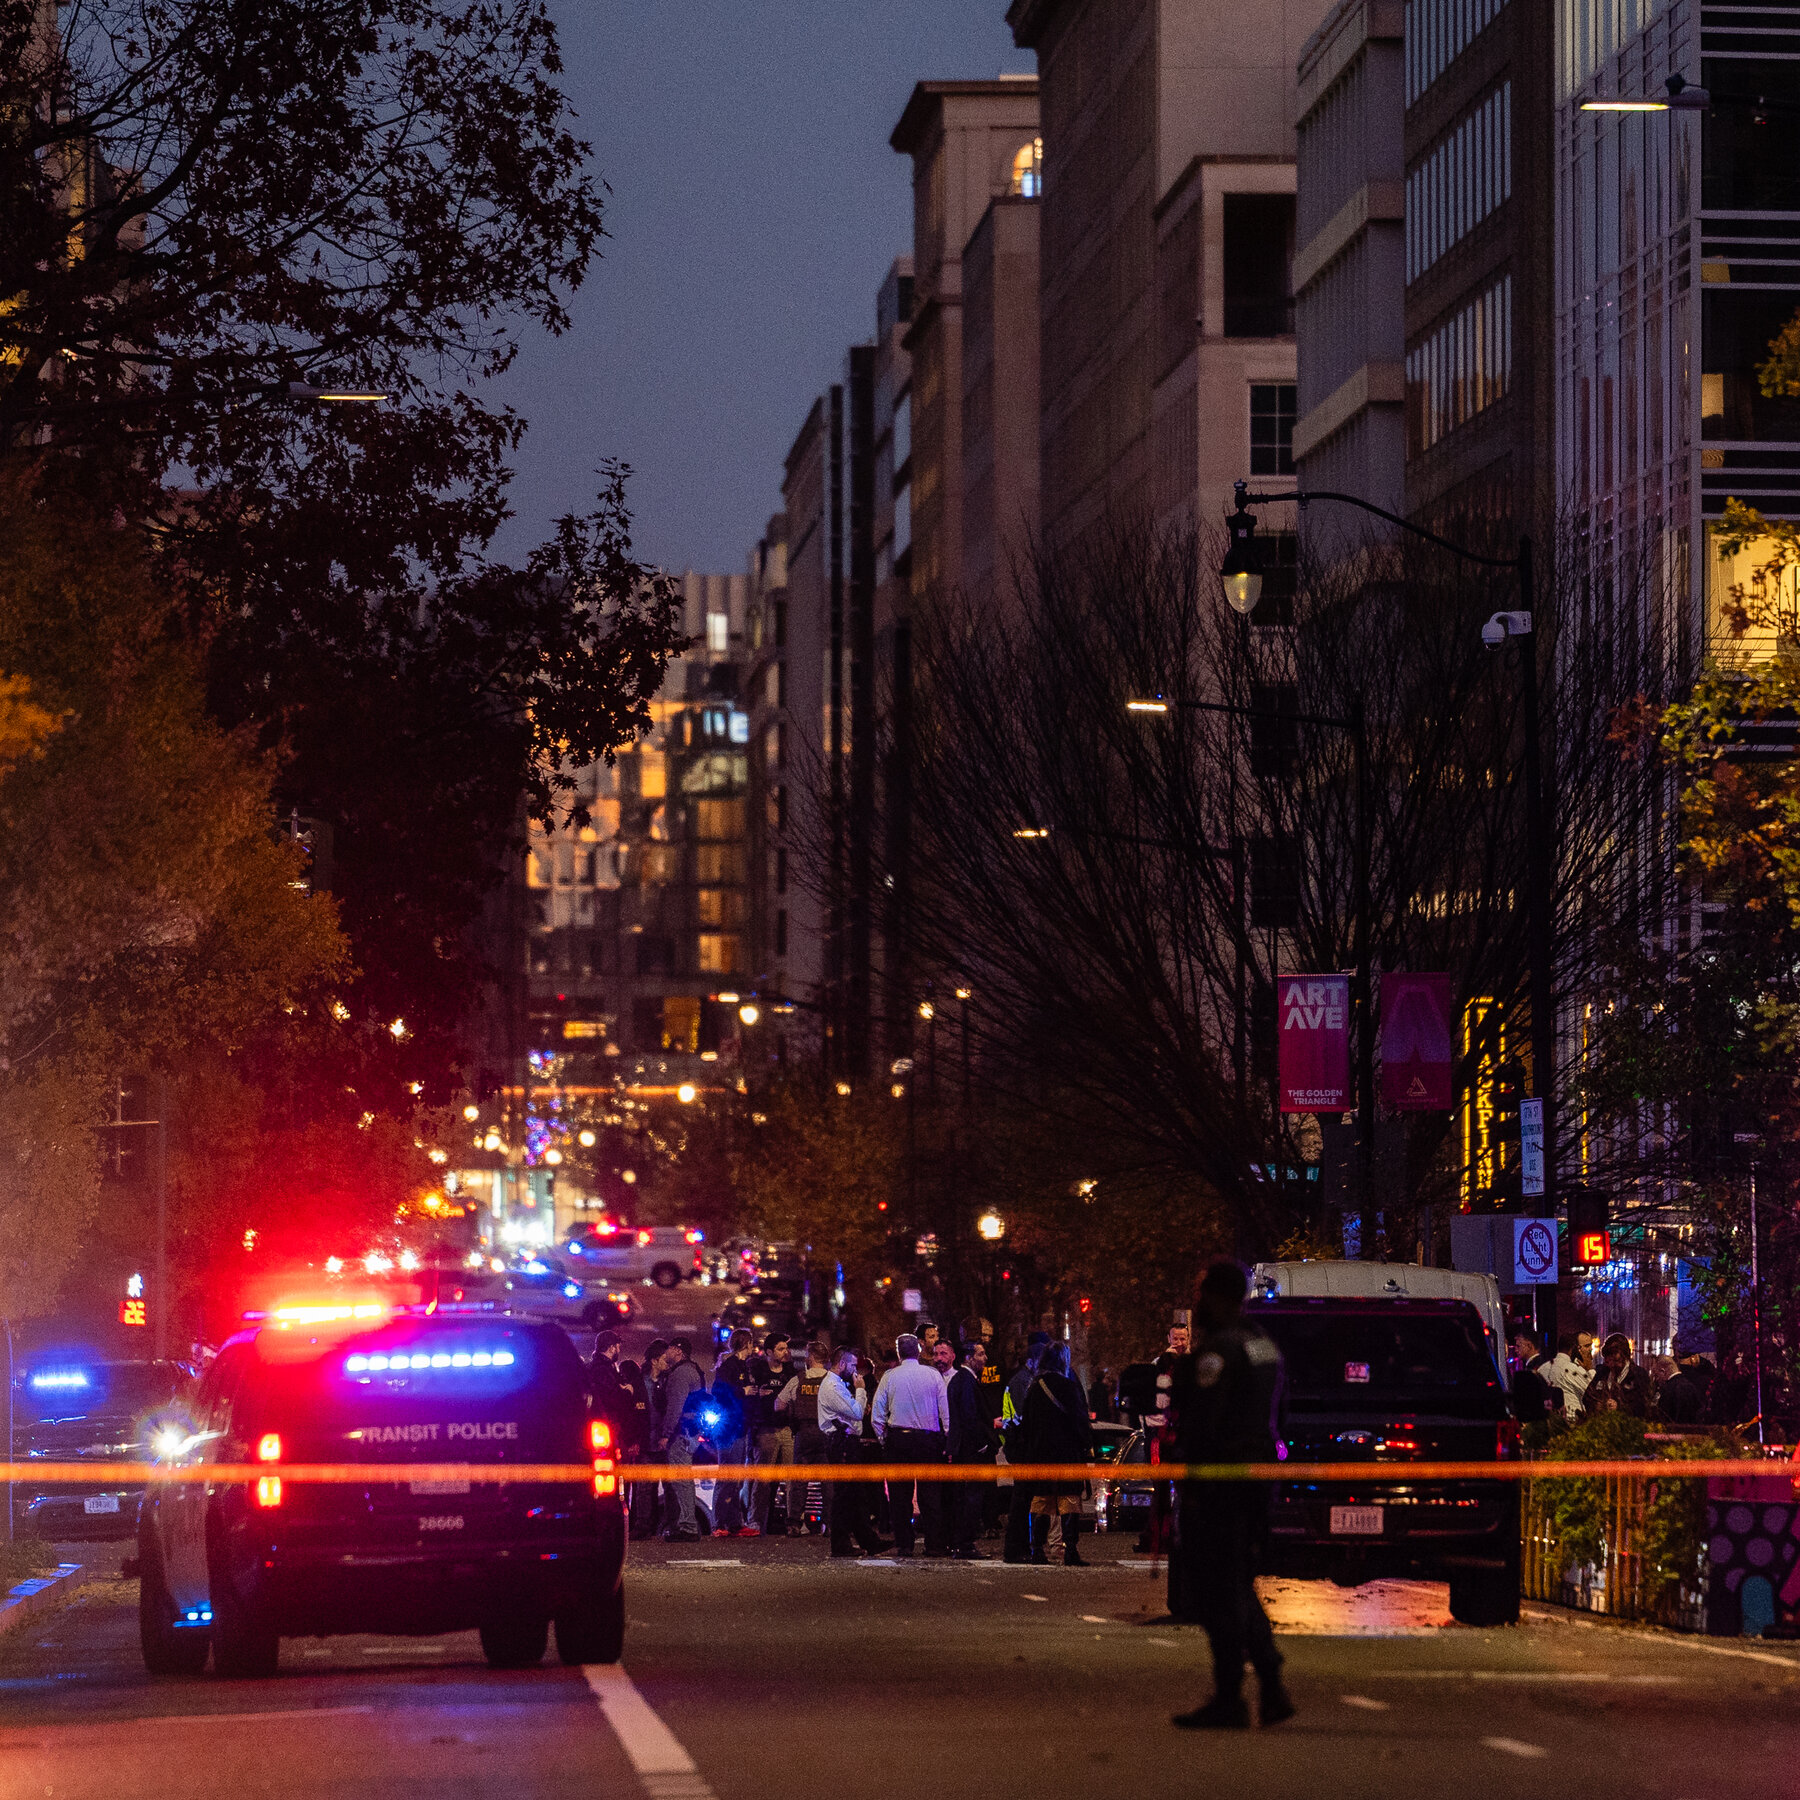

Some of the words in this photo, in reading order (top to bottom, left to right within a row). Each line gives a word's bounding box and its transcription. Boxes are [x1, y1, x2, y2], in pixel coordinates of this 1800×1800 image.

[1284, 982, 1344, 1006] ART
[1284, 1007, 1343, 1030] AVE
[1287, 1089, 1305, 1098] THE
[1306, 1089, 1343, 1098] GOLDEN
[1294, 1097, 1337, 1106] TRIANGLE
[1528, 1230, 1544, 1240] Red
[1583, 1236, 1604, 1261] 15
[982, 1365, 997, 1377] ATF
[356, 1423, 440, 1444] TRANSIT
[447, 1421, 519, 1440] POLICE
